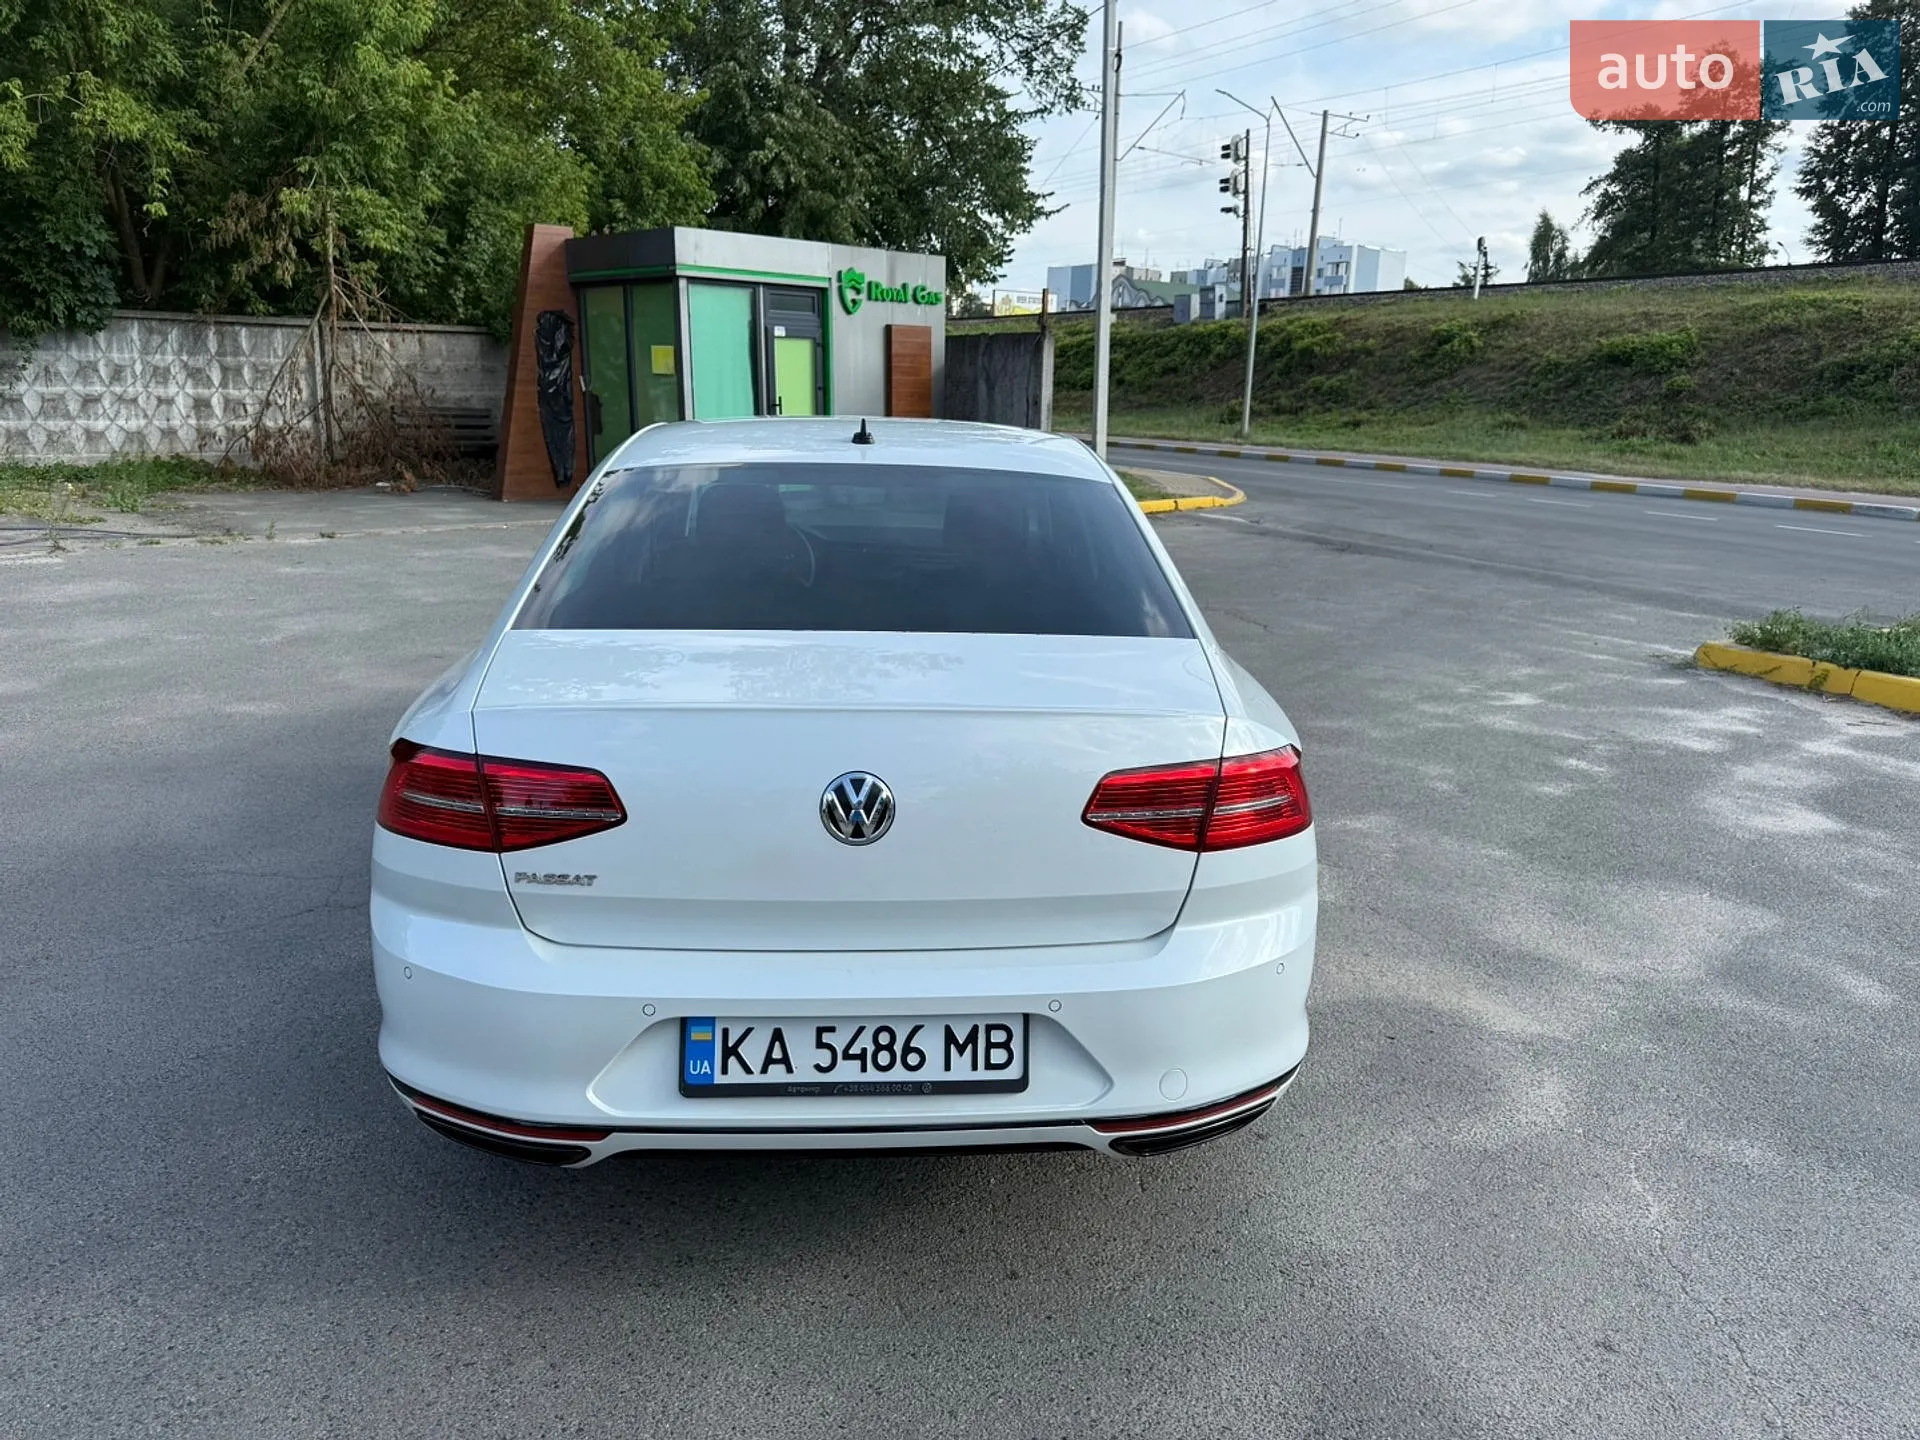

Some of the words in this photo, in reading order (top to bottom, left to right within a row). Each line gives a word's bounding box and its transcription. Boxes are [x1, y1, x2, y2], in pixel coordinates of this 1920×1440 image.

[514, 871, 598, 887] PASSAT
[720, 1026, 794, 1076] KA
[813, 1024, 927, 1074] 5486
[943, 1023, 1015, 1072] MB
[689, 1059, 711, 1075] UA
